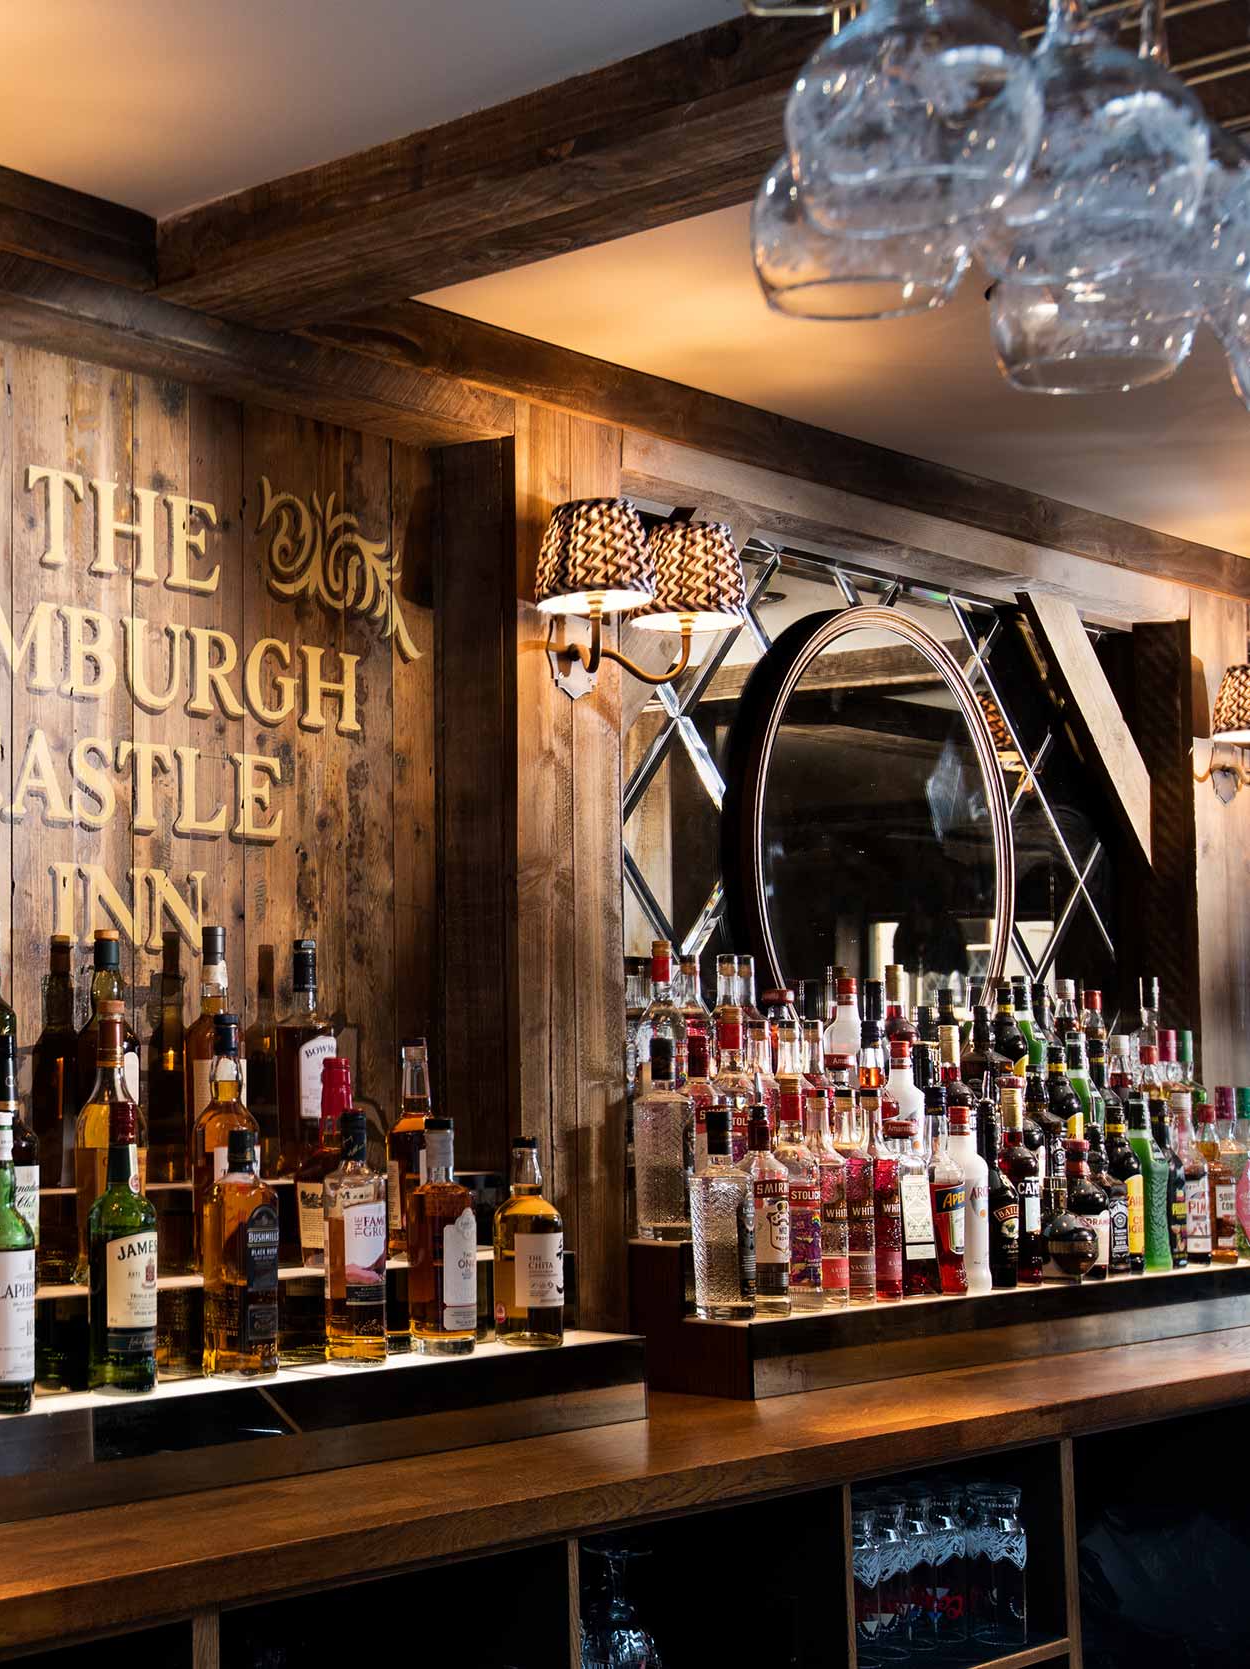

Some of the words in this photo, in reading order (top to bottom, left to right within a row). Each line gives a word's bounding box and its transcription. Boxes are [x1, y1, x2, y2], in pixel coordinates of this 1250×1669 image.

[26, 464, 221, 595] THE
[48, 861, 206, 954] INN
[528, 1261, 554, 1269] CHITA
